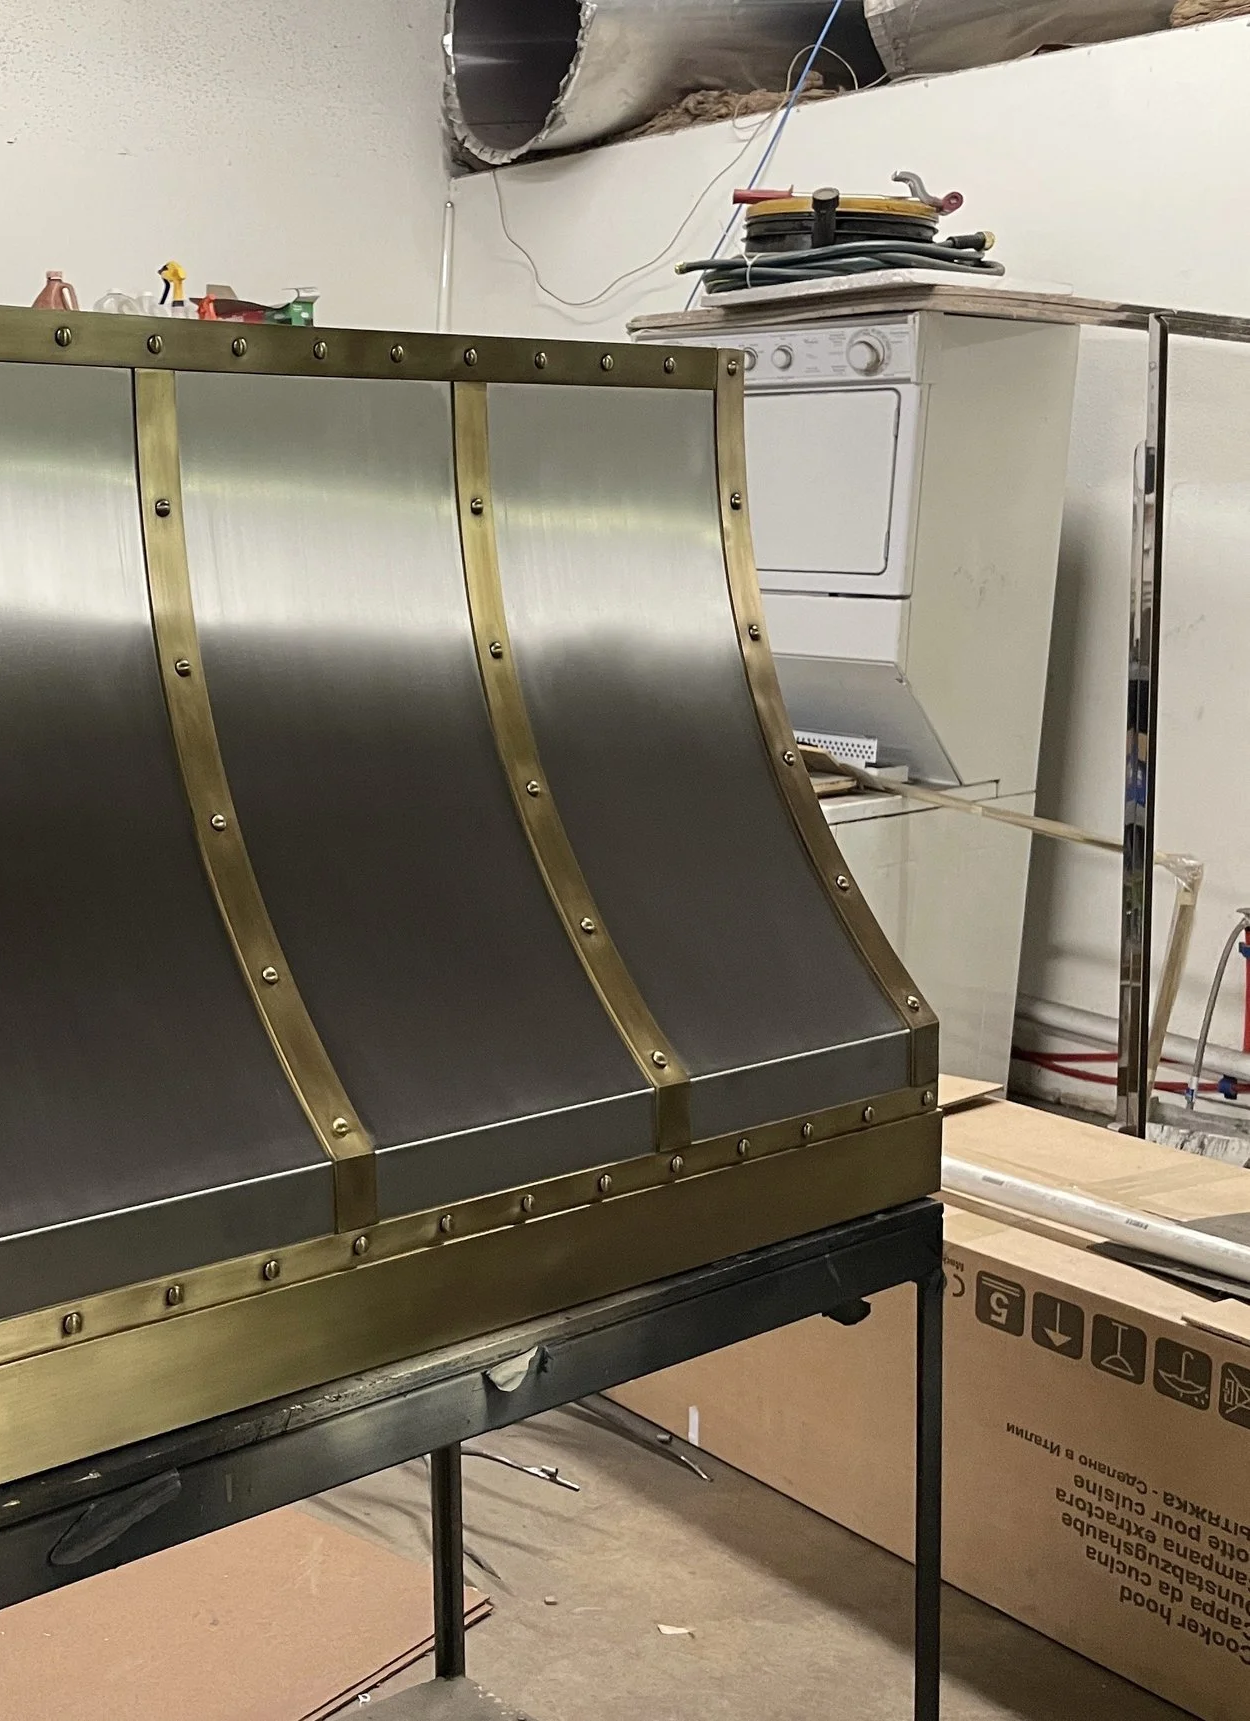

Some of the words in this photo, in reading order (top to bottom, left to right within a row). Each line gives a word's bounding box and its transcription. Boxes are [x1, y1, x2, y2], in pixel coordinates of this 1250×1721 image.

[990, 1291, 1009, 1325] 5
[1006, 1422, 1060, 1457] Италии
[1065, 1449, 1074, 1461] в
[1078, 1454, 1148, 1495] Сделано
[1055, 1487, 1156, 1543] extractora
[1073, 1474, 1145, 1516] cuisine
[1151, 1510, 1201, 1542] pour
[1162, 1491, 1250, 1541] ытяжка
[1086, 1545, 1151, 1586] cucina
[1163, 1537, 1250, 1588] ampana
[1208, 1535, 1250, 1562] otte
[1120, 1585, 1171, 1625] hood
[1158, 1579, 1183, 1603] da
[1177, 1613, 1250, 1665] Cooker
